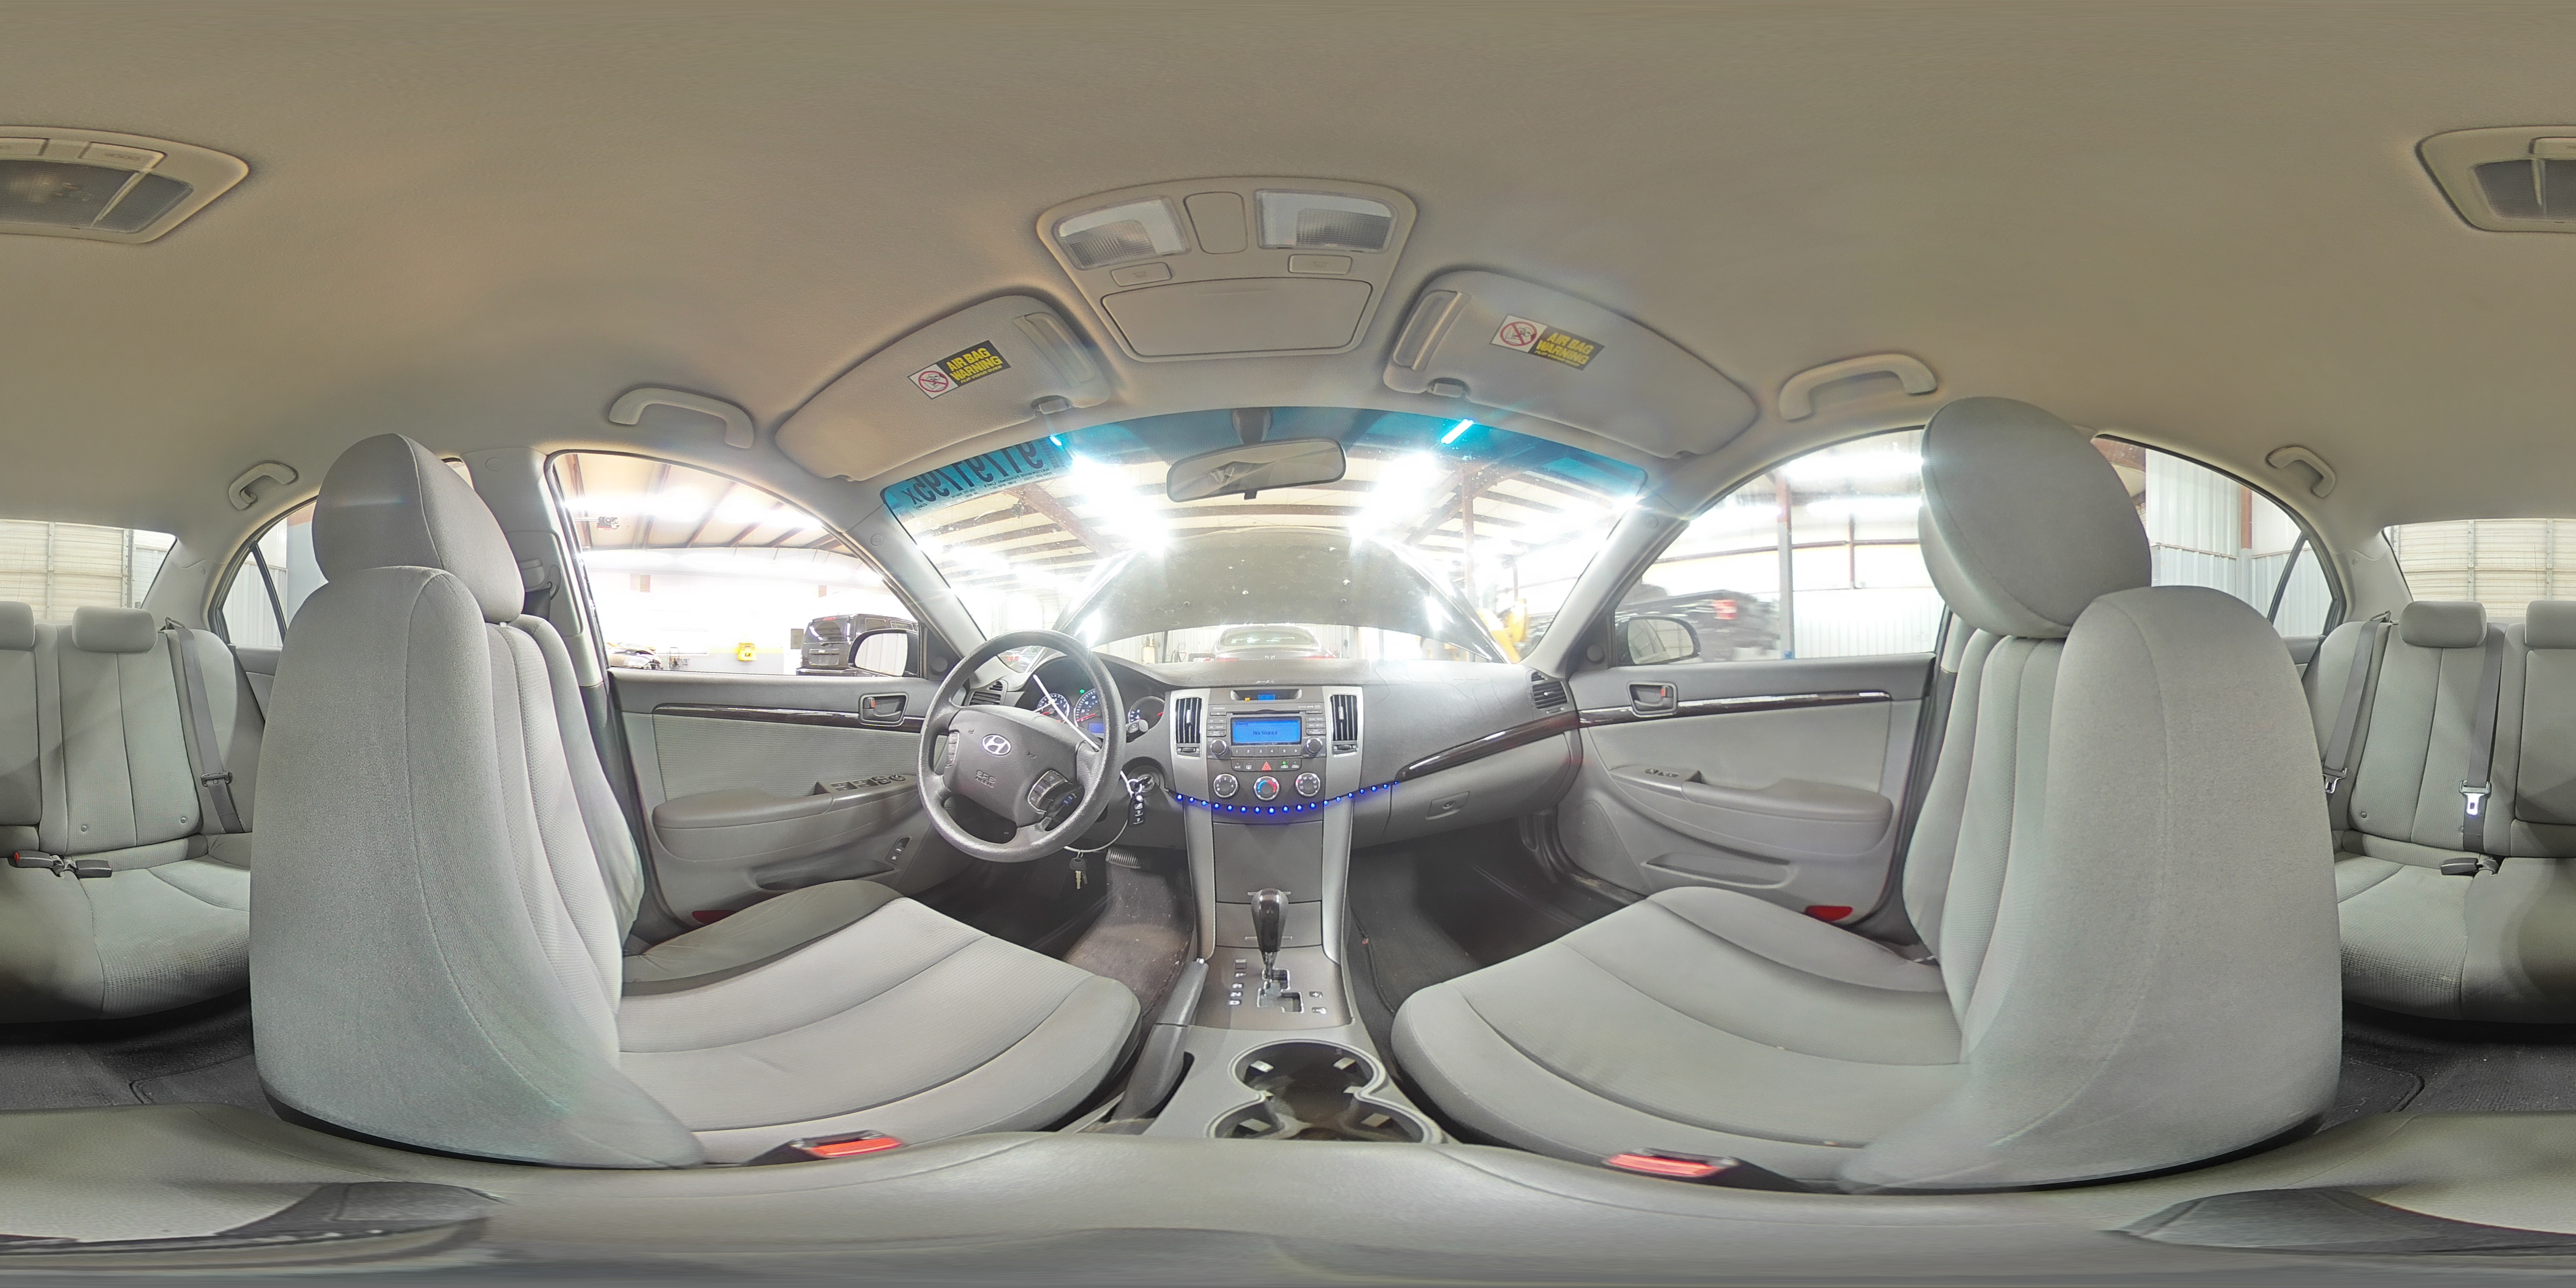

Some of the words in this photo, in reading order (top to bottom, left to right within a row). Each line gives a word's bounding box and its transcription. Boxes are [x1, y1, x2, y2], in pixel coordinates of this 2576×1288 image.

[1536, 340, 1590, 365] WARNING
[1547, 333, 1571, 346] AIR
[1567, 339, 1594, 355] BAG
[946, 357, 968, 371] AIR
[962, 348, 991, 364] BAG
[950, 356, 1003, 380] WARNING
